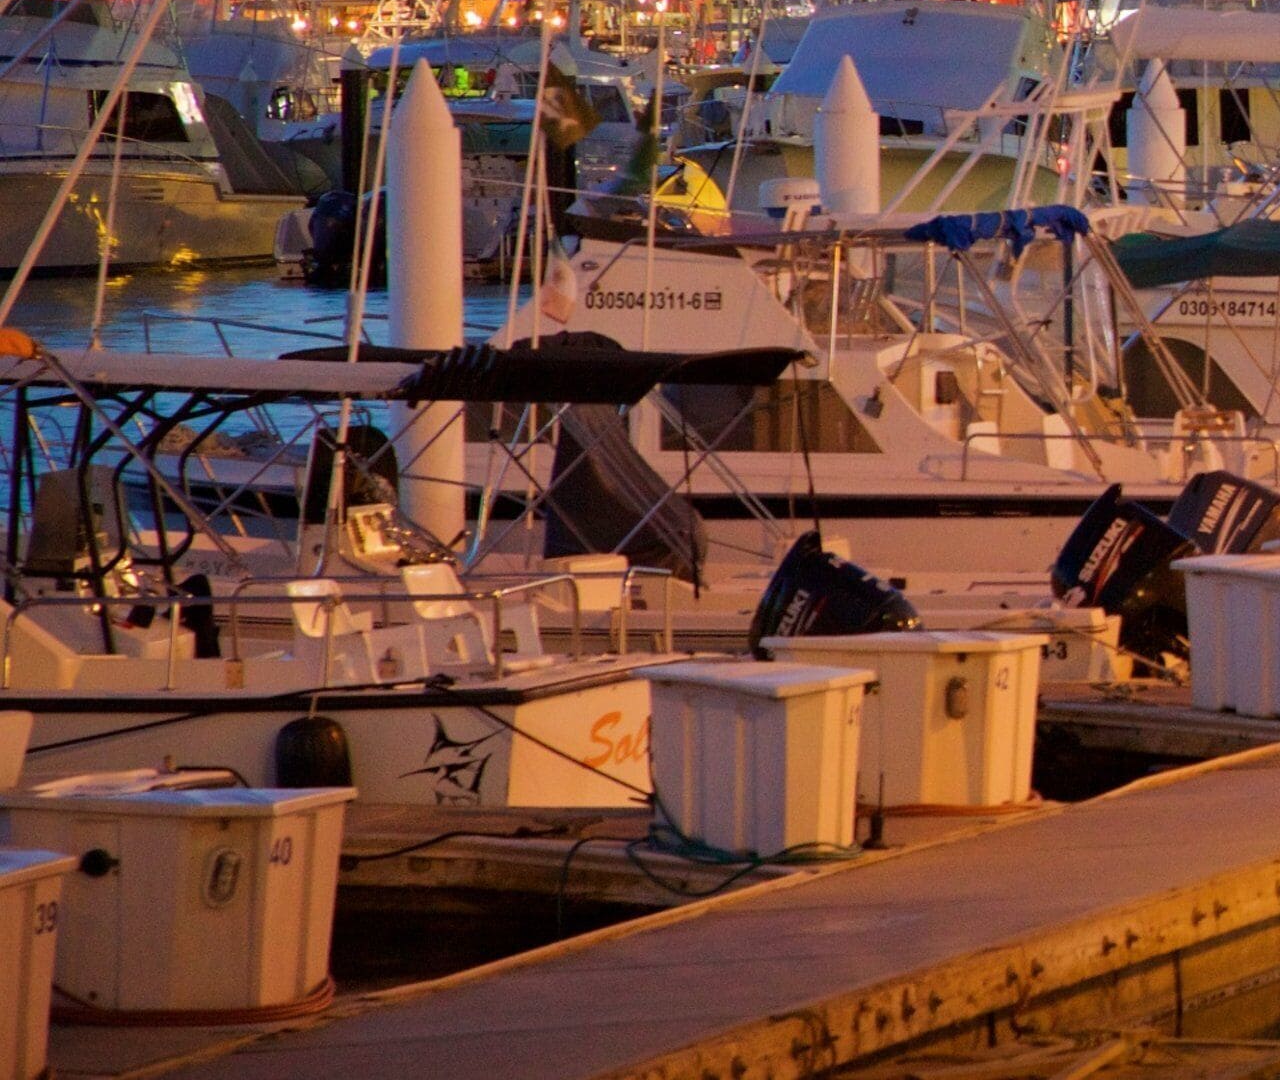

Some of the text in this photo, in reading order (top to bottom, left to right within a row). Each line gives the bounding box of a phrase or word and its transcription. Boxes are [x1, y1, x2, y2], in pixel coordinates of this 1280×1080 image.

[1197, 483, 1237, 535] YAMAHA
[1078, 517, 1129, 583] SUZUKI
[775, 589, 811, 637] ZUKI
[268, 835, 293, 866] 40
[35, 900, 59, 935] 39
